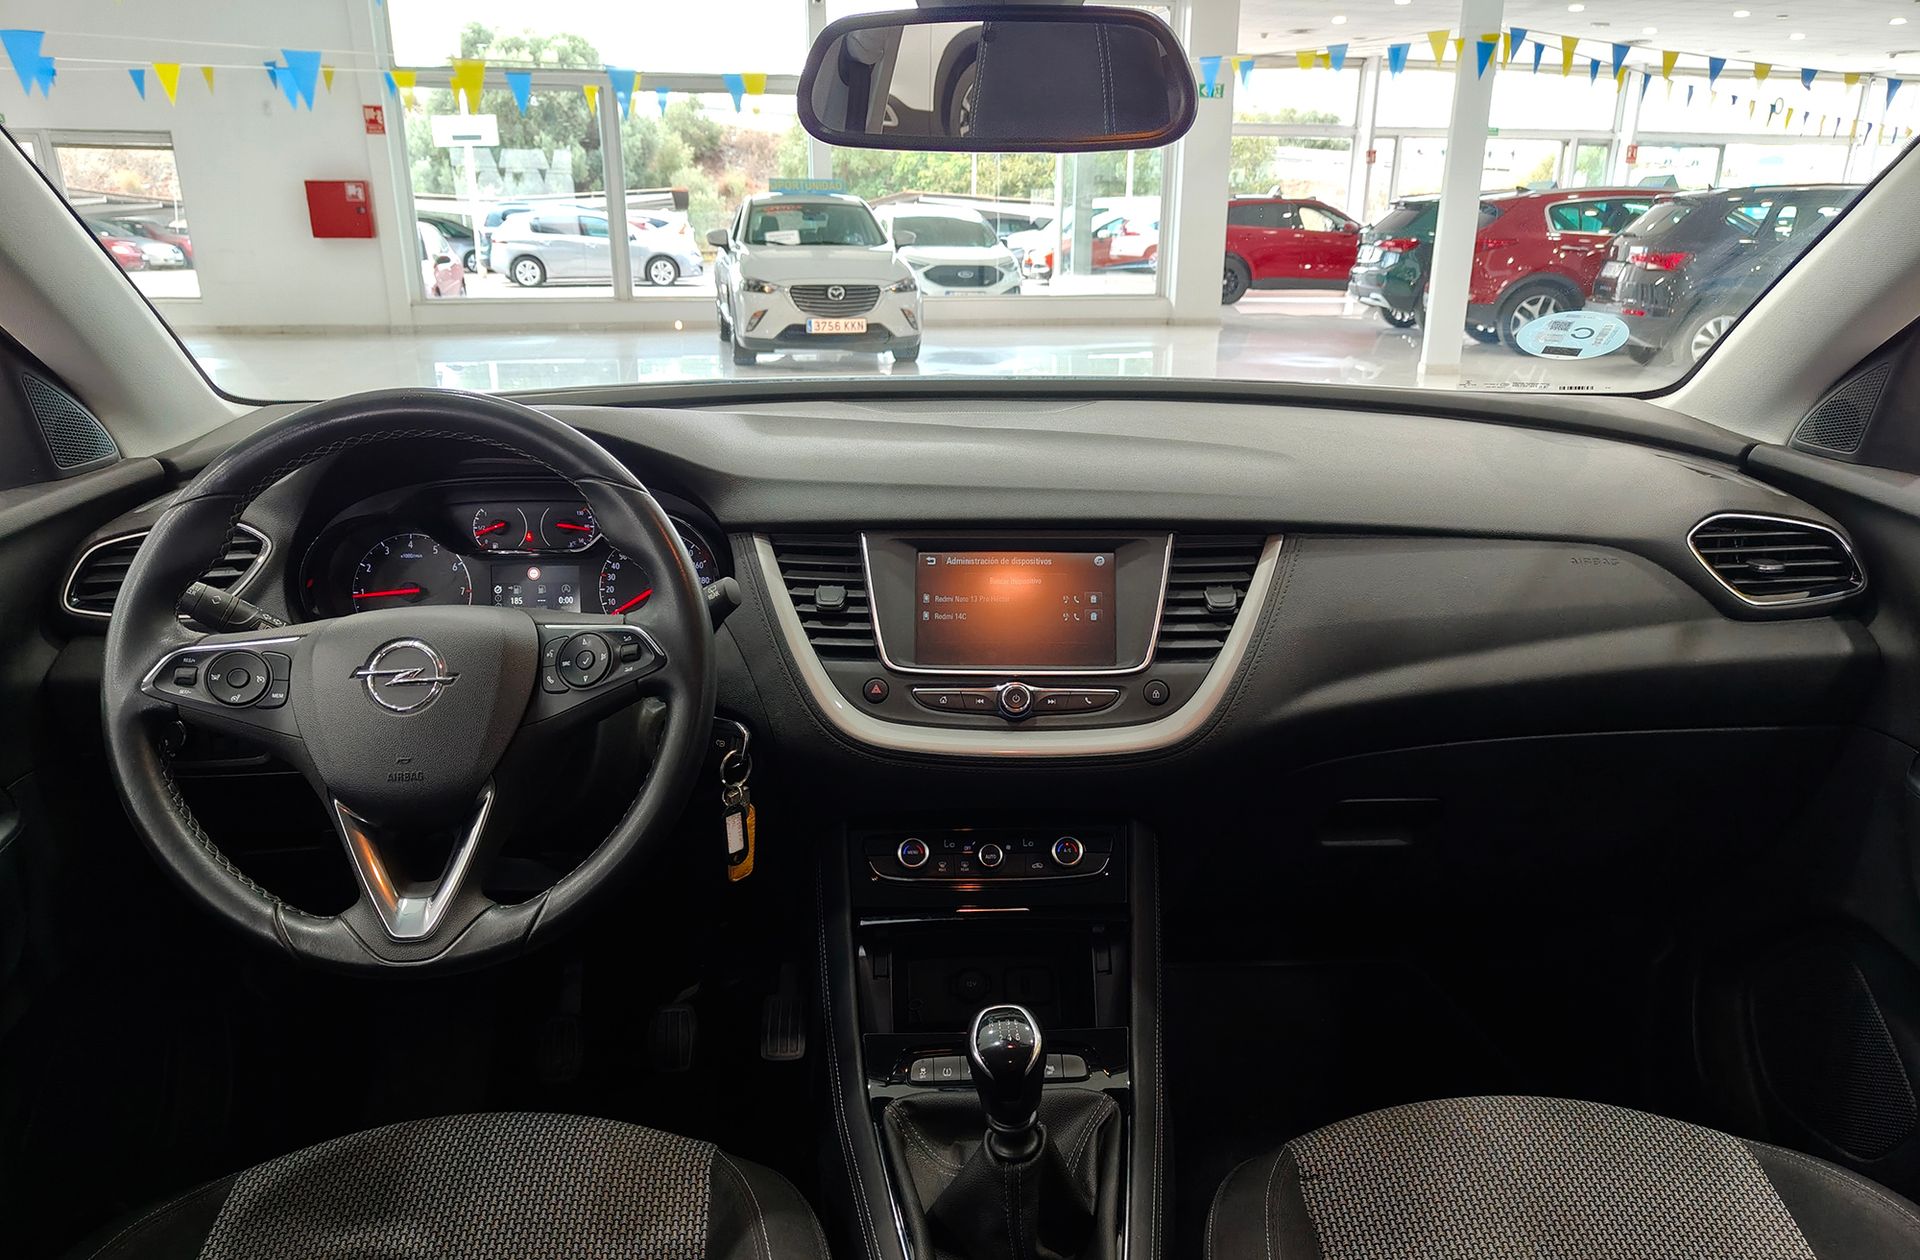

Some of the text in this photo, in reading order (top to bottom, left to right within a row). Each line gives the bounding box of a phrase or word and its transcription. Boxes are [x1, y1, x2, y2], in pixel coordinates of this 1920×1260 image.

[814, 321, 863, 331] 3756 KKN
[408, 540, 413, 549] 4
[385, 546, 390, 555] 3
[433, 545, 438, 554] 5
[612, 562, 620, 570] 40
[946, 557, 1052, 567] Administración de dispositivos
[1570, 557, 1619, 566] AIRBAG
[366, 563, 371, 573] 2
[452, 562, 458, 572] 6
[607, 573, 616, 581] 30
[460, 587, 465, 596] 7
[606, 585, 615, 593] 20
[511, 597, 523, 605] 185
[558, 596, 573, 604] 0:00
[608, 598, 616, 606] 10
[935, 595, 954, 603] Redmi
[935, 612, 967, 620] Redmi 14C
[386, 771, 424, 781] AIRBAG
[943, 839, 956, 848] Lo
[1022, 838, 1034, 847] Lo
[1015, 1033, 1021, 1041] 6
